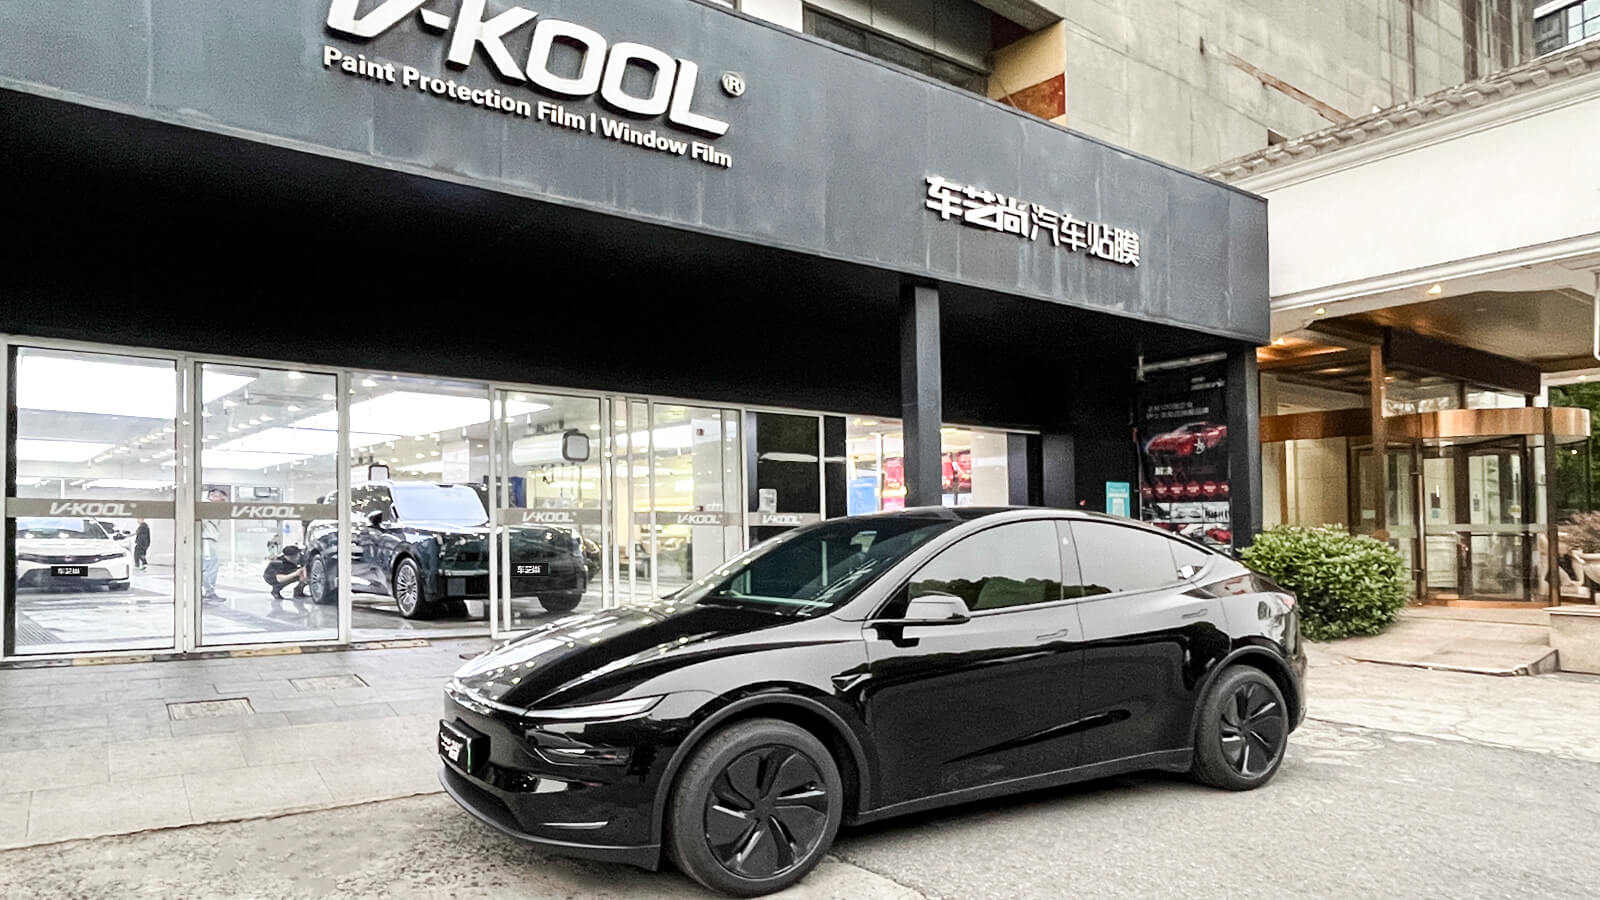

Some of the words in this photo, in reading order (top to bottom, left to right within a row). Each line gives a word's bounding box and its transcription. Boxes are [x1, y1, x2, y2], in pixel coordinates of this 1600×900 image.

[323, 45, 396, 83] Paint
[402, 65, 531, 117] Protection
[537, 101, 586, 131] Film
[601, 117, 688, 155] Window
[691, 141, 733, 168] Film
